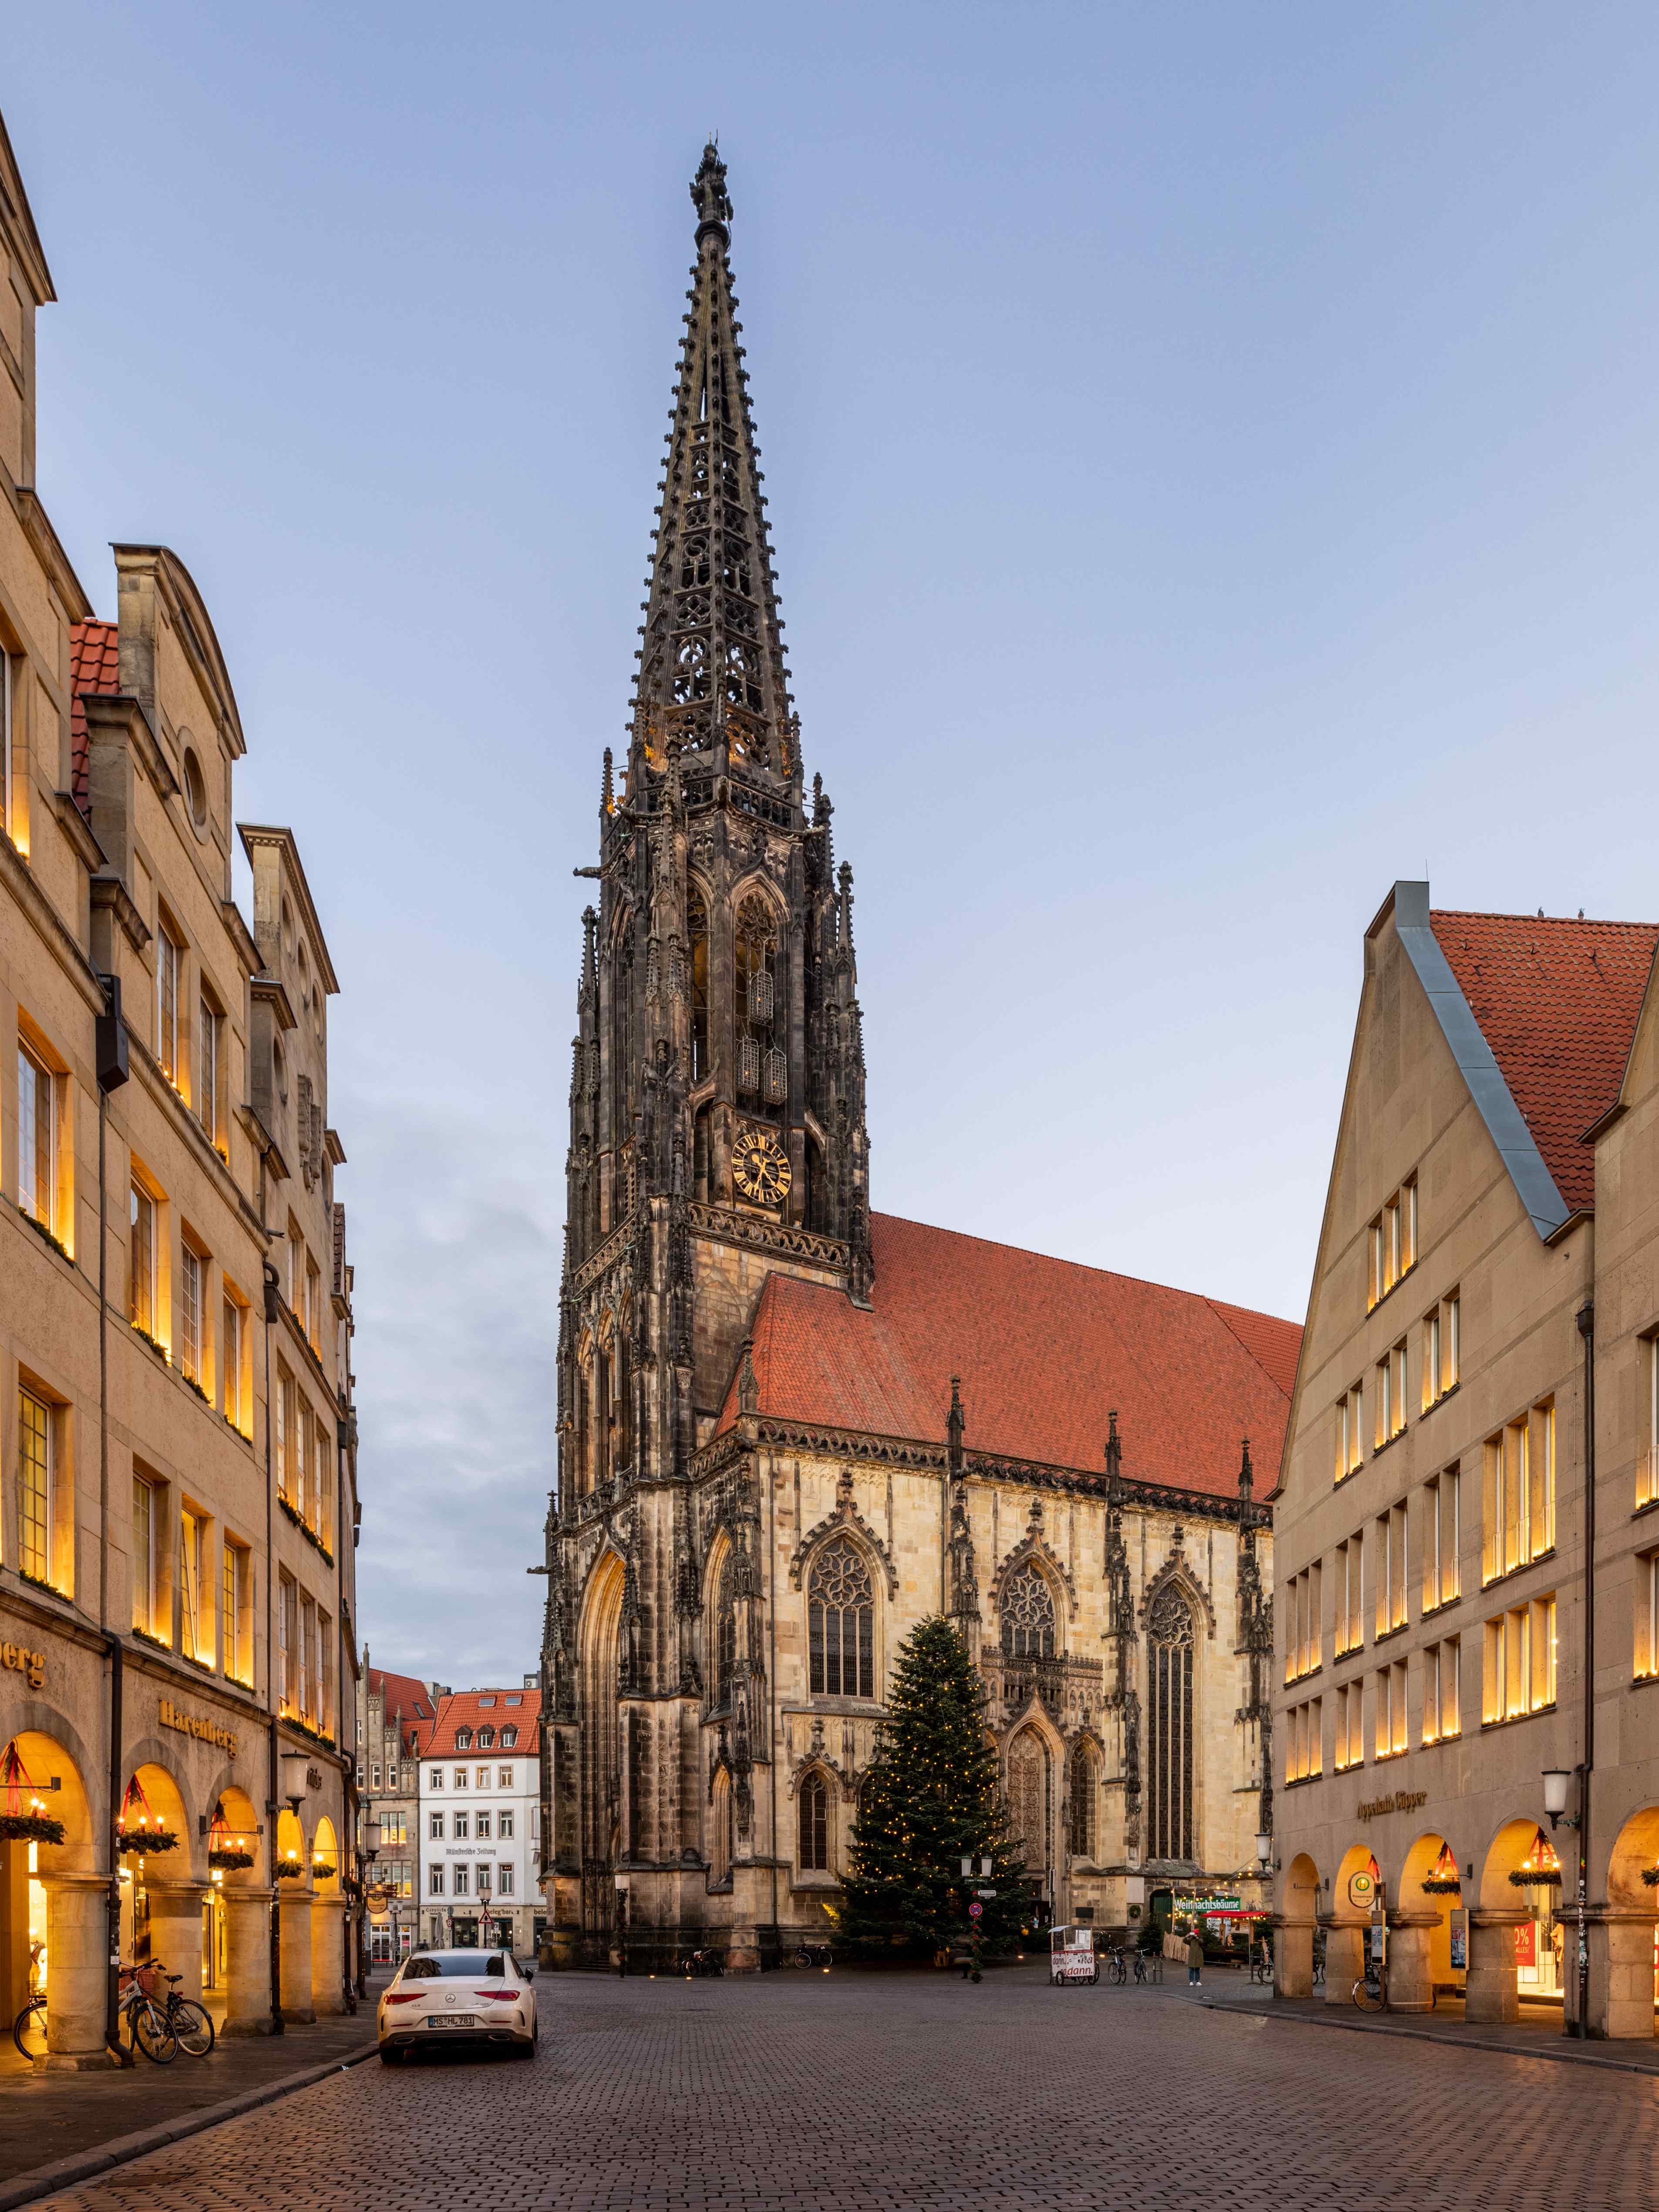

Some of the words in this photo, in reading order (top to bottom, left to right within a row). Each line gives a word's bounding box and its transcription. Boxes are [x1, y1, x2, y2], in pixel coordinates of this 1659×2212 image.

[0, 1642, 47, 1690] erg
[158, 1699, 238, 1759] Harenberg
[1395, 1791, 1427, 1814] Cüpper
[1514, 1928, 1529, 1945] 0%
